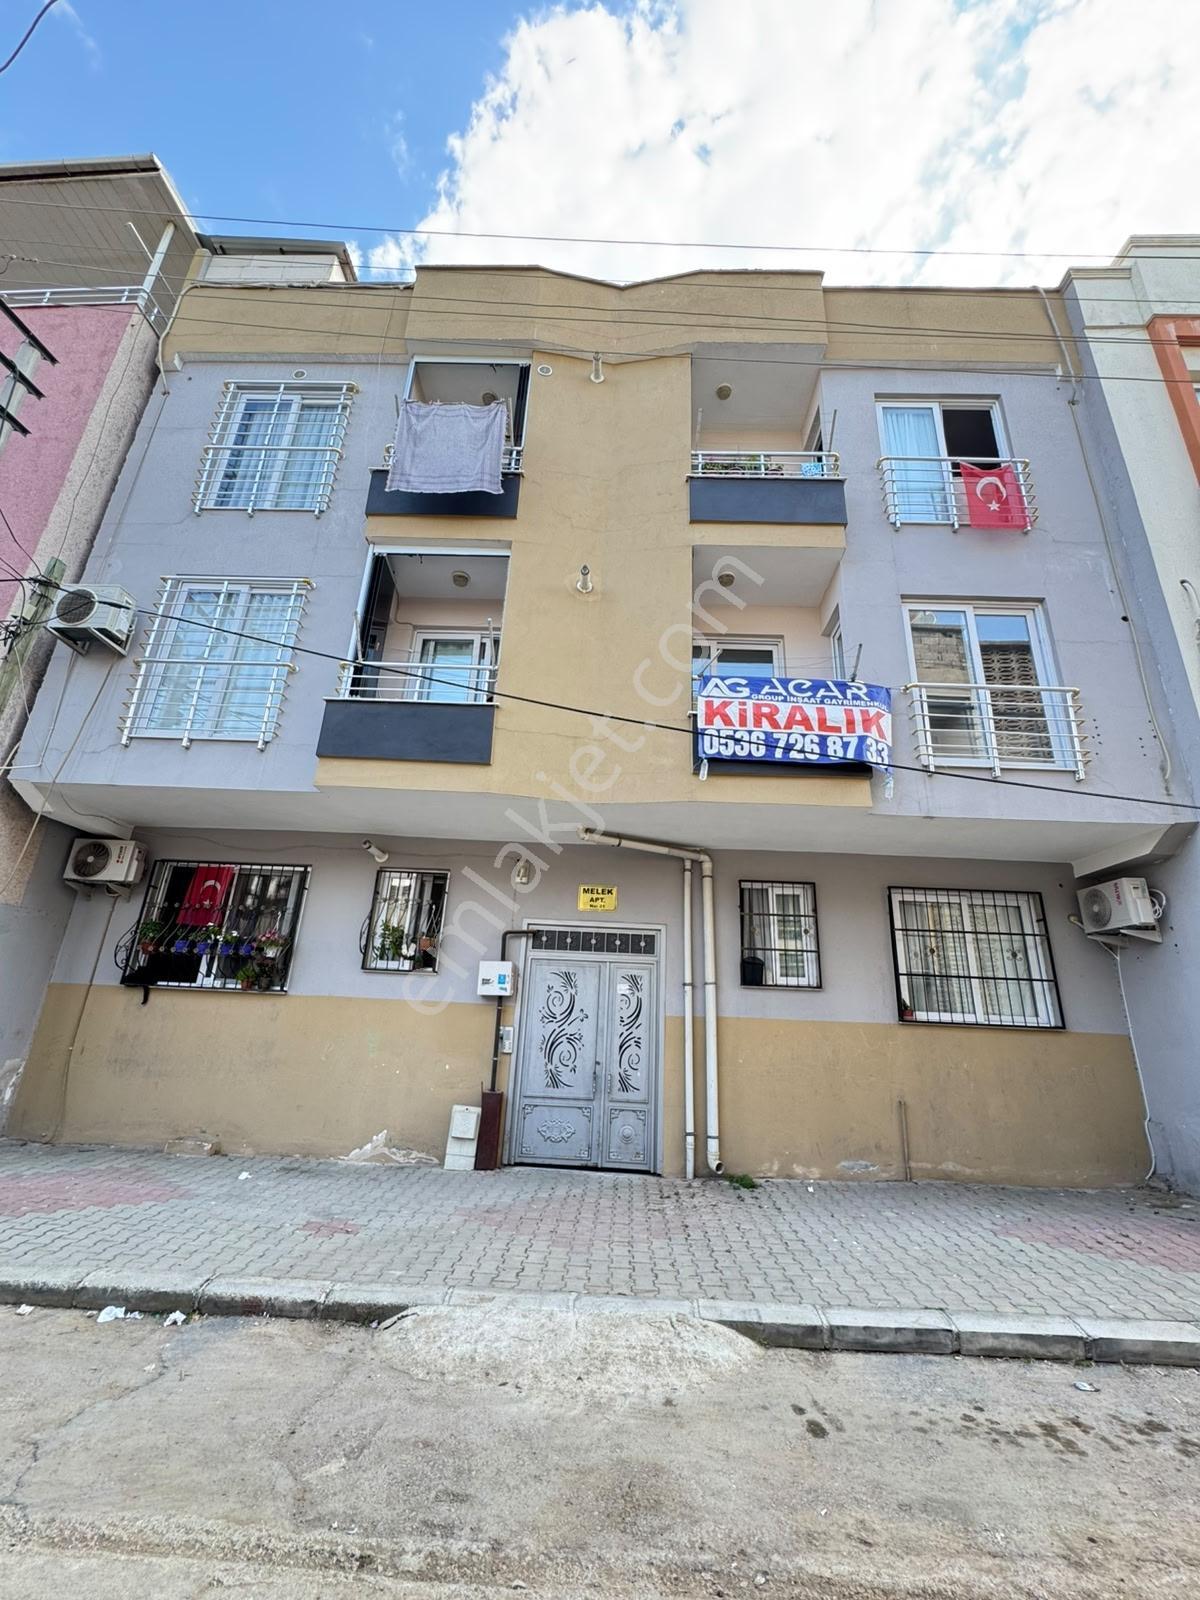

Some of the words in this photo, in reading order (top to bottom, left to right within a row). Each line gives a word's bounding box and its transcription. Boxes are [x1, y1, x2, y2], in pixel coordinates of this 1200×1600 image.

[701, 677, 750, 698] AG
[761, 678, 870, 701] ACAR
[751, 693, 785, 702] GROUP
[703, 729, 766, 757] 0536
[773, 733, 820, 760] 726
[826, 734, 859, 760] 87
[865, 737, 889, 769] 33
[583, 887, 614, 896] MELEK
